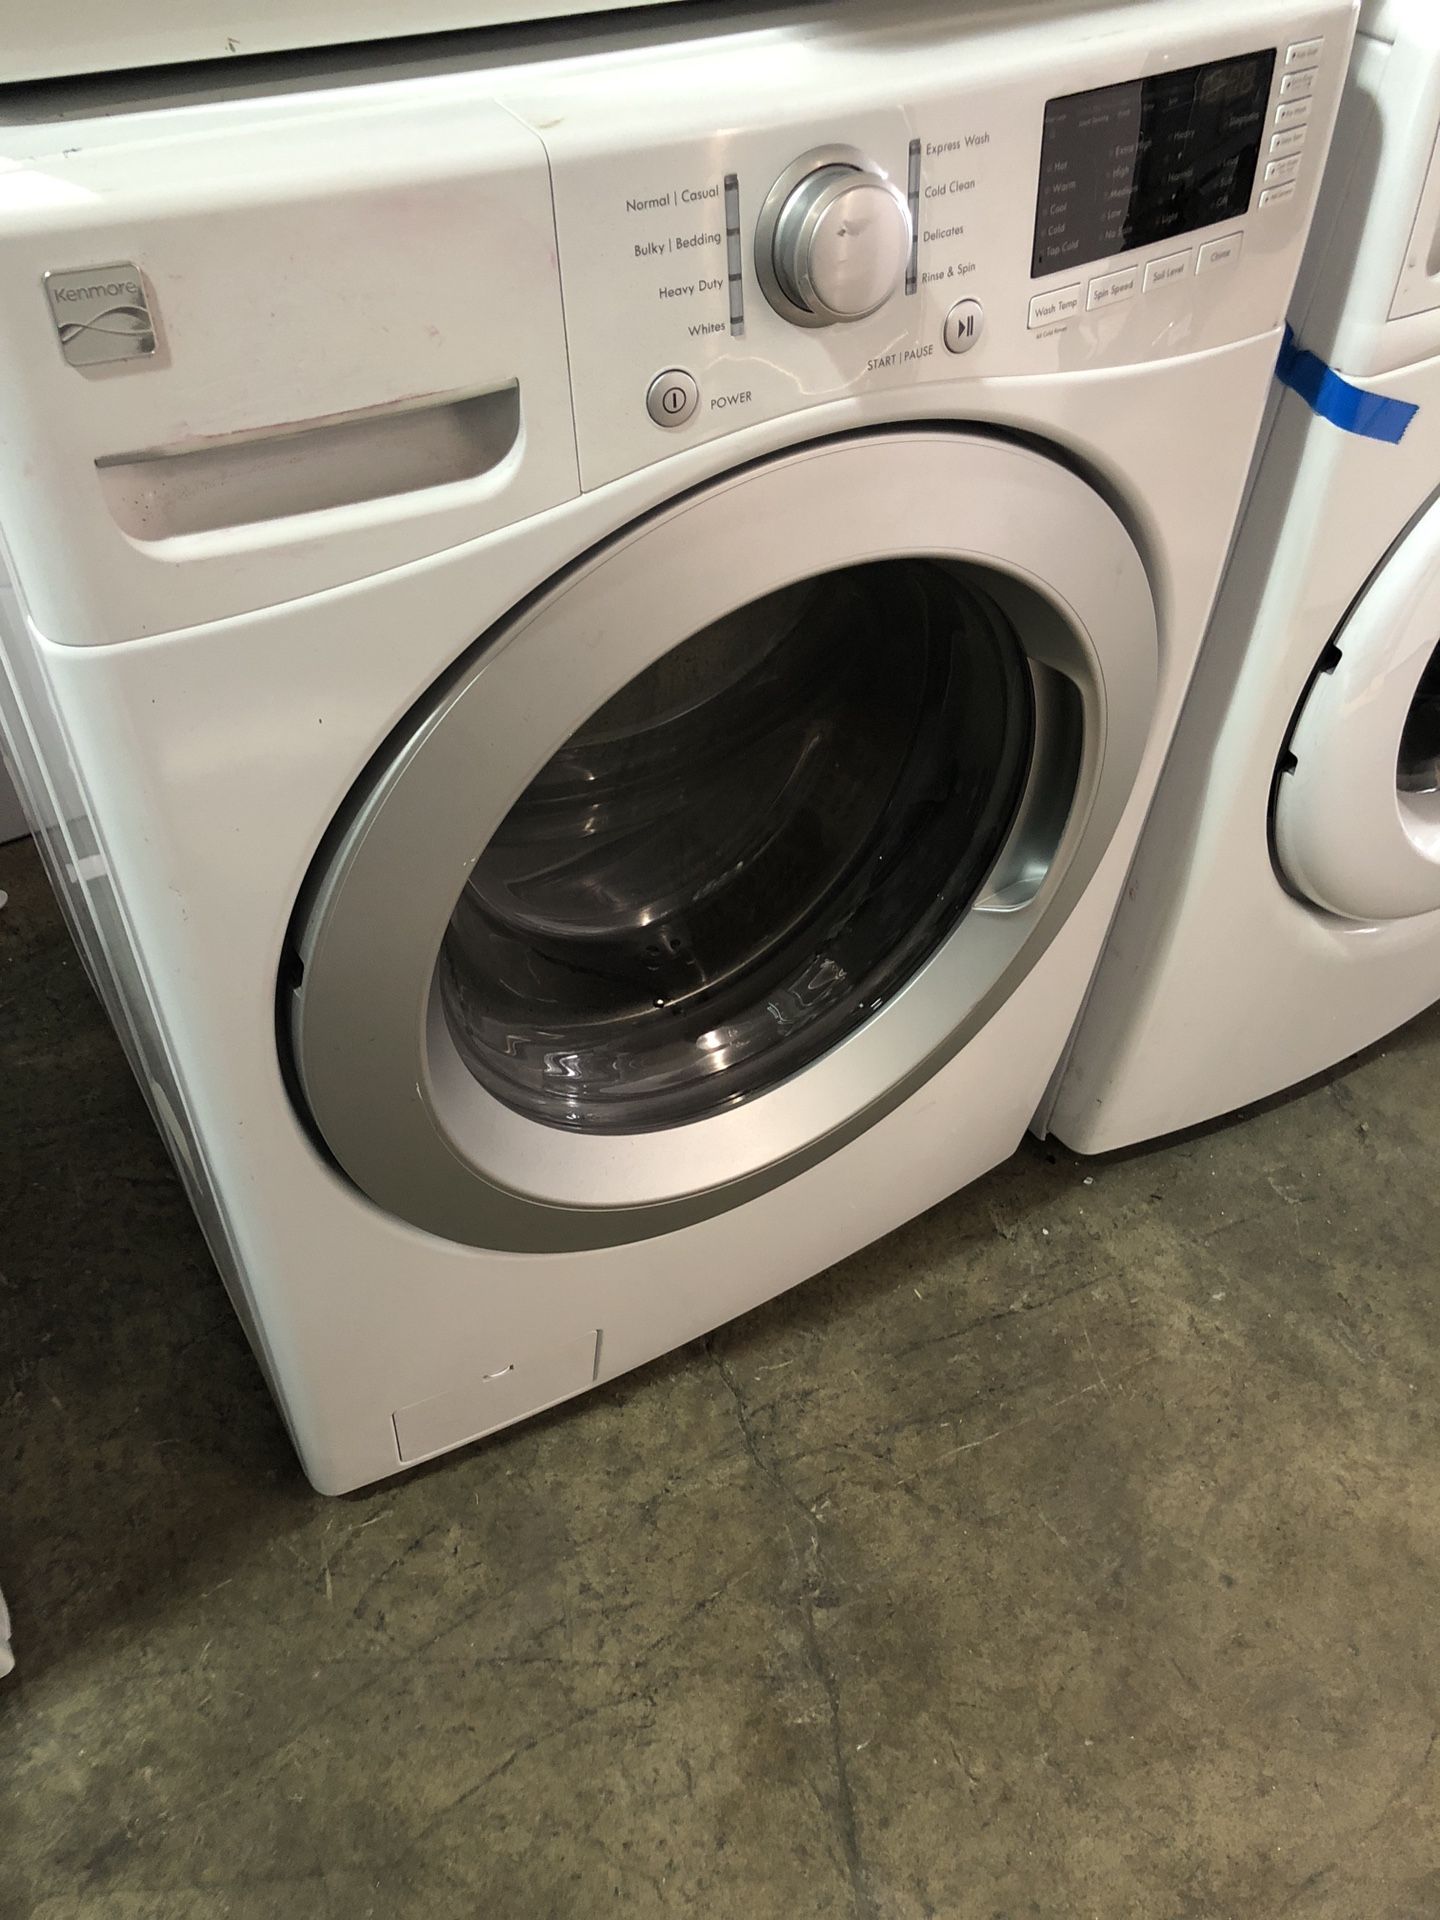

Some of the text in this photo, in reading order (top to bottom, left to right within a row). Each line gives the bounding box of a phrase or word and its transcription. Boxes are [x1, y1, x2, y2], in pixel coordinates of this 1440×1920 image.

[925, 132, 991, 155] Express Wash
[924, 179, 976, 199] Cold Clean
[1052, 180, 1077, 194] Warm
[626, 186, 719, 212] Normal Casual
[923, 224, 965, 242] Delicates
[1047, 223, 1066, 237] Cold
[634, 231, 722, 258] Bulky Bedding
[1046, 238, 1080, 257] Tap Cold
[921, 270, 945, 284] Rinse
[957, 262, 977, 277] Spin
[1152, 264, 1185, 281] Soil Level
[55, 281, 138, 304] Kenmore
[659, 278, 724, 300] Heavy Duty
[1093, 279, 1135, 301] Spin Speed
[1034, 297, 1078, 318] Wash Temp
[688, 321, 726, 337] Whites
[867, 345, 935, 371] START PAUSE
[710, 391, 753, 410] POWER
